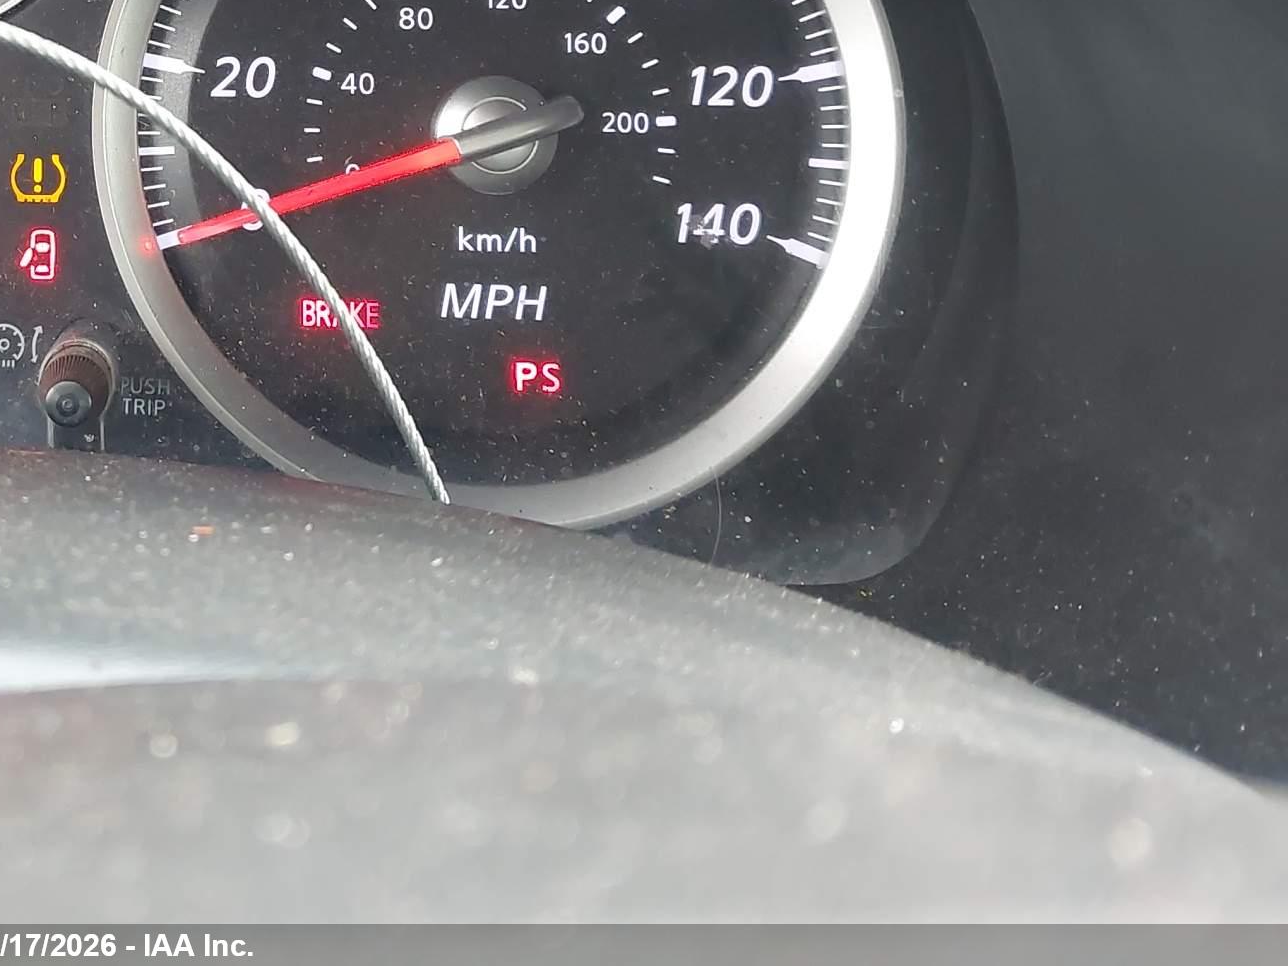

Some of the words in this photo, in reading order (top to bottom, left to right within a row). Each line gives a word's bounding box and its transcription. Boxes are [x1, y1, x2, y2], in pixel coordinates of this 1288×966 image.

[399, 6, 433, 30] 80
[564, 31, 608, 55] 160
[210, 56, 276, 100] 20
[340, 72, 375, 94] 40
[689, 66, 773, 108] 120
[601, 111, 650, 134] 200
[676, 203, 761, 245] 140
[457, 225, 538, 254] km/h
[301, 299, 379, 330] BRKE
[440, 283, 547, 321] MPH
[120, 380, 171, 396] PUSH
[514, 362, 562, 393] PS
[123, 398, 167, 416] TRIP
